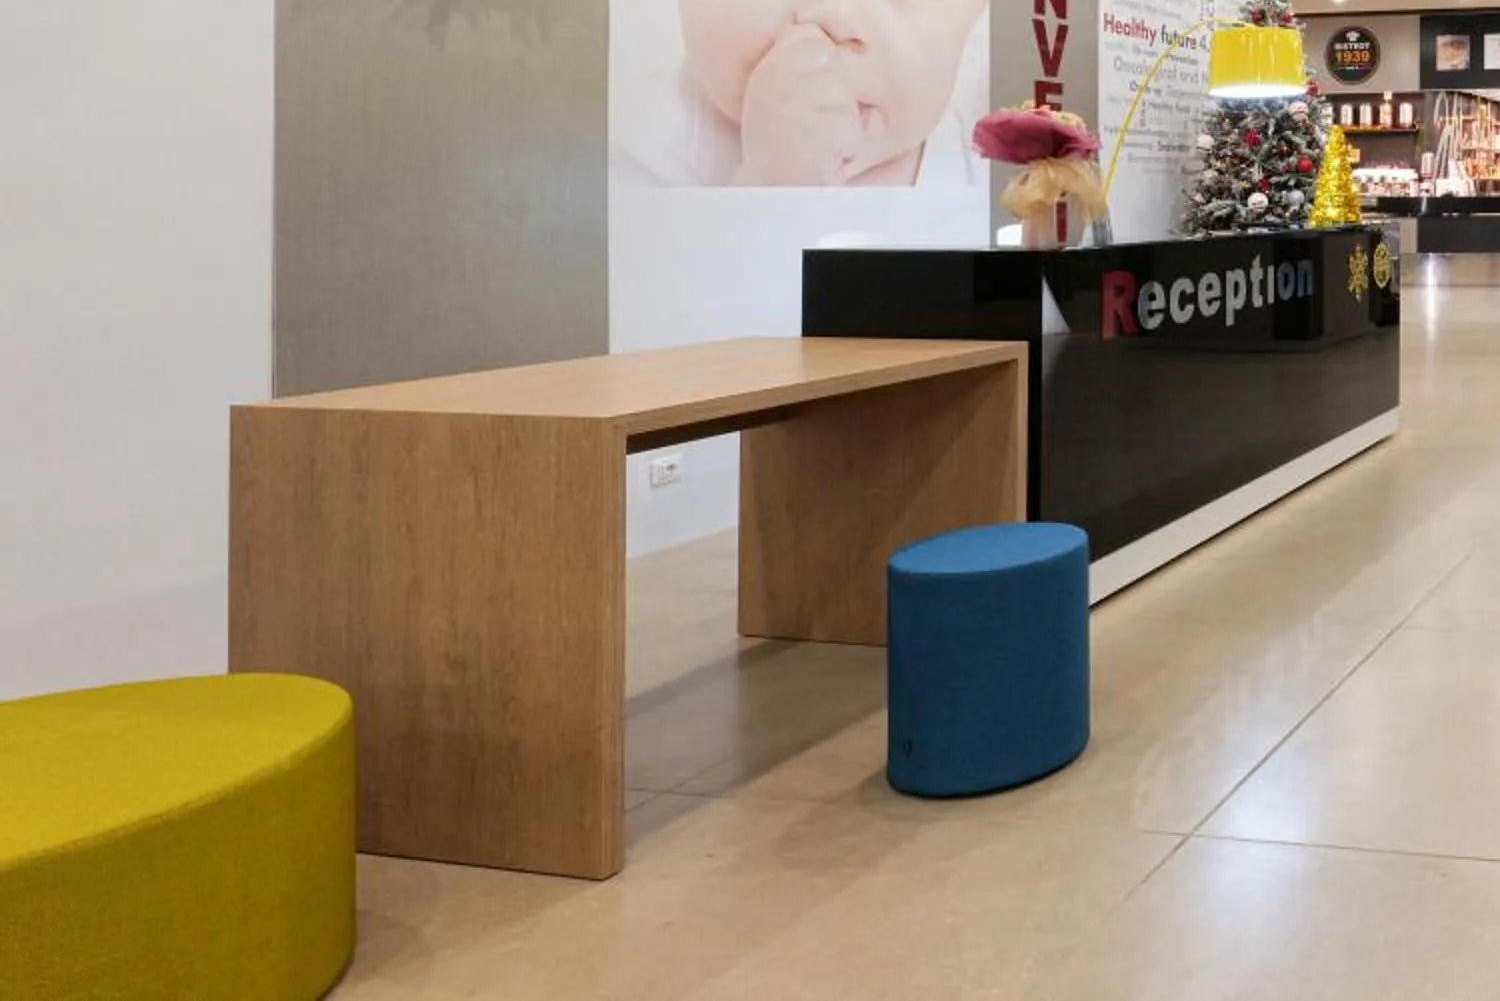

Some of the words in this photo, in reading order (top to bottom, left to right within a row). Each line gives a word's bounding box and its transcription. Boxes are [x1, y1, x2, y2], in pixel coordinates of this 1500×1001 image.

[1103, 12, 1157, 48] Healthy
[1161, 23, 1197, 50] future
[1101, 255, 1313, 340] Reception
